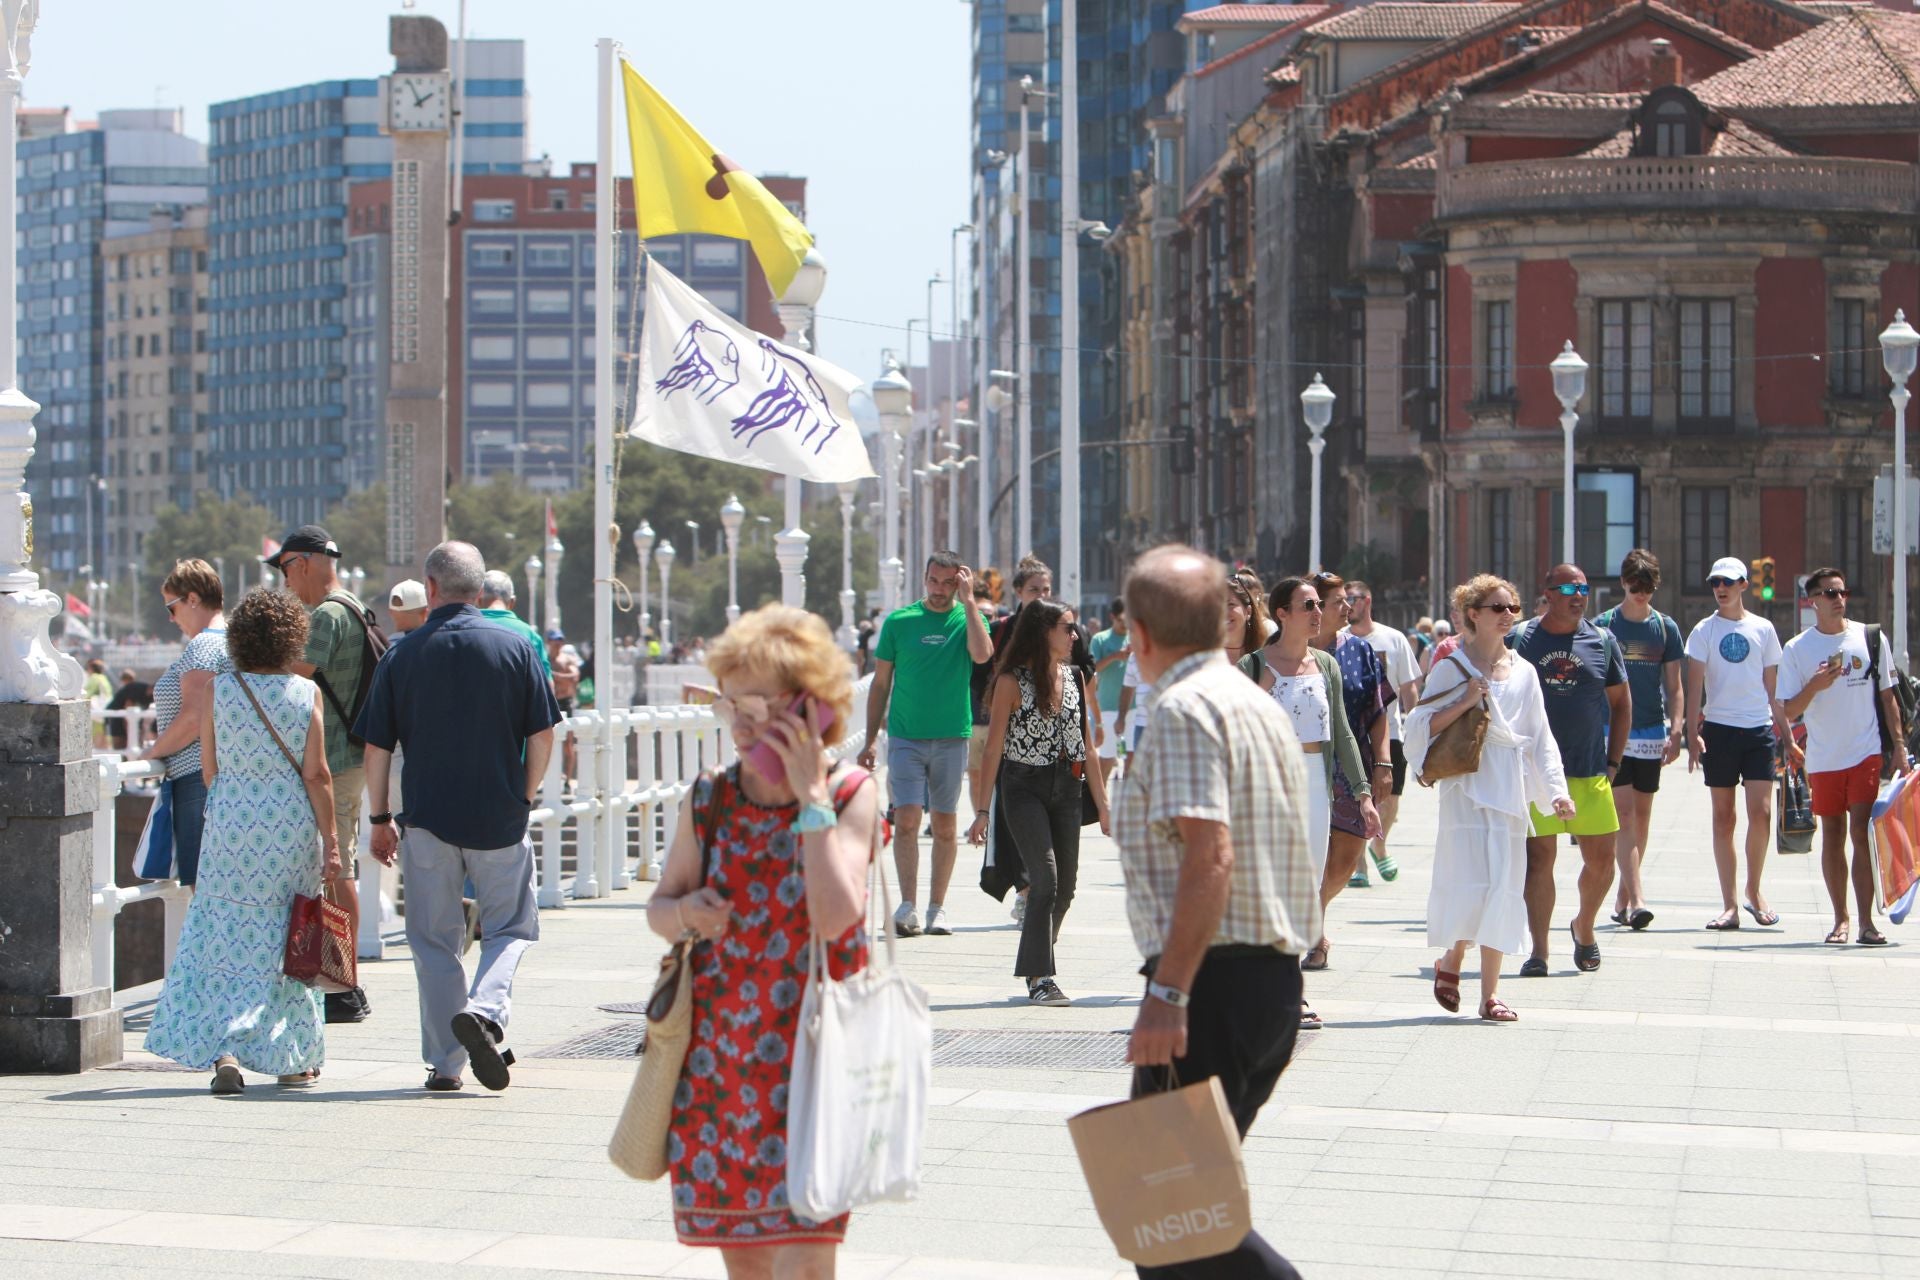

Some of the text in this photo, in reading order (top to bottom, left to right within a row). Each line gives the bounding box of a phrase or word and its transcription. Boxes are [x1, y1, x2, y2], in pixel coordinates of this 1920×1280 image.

[1539, 650, 1585, 668] SUMMER TIME
[1133, 1202, 1233, 1249] INSIDE
